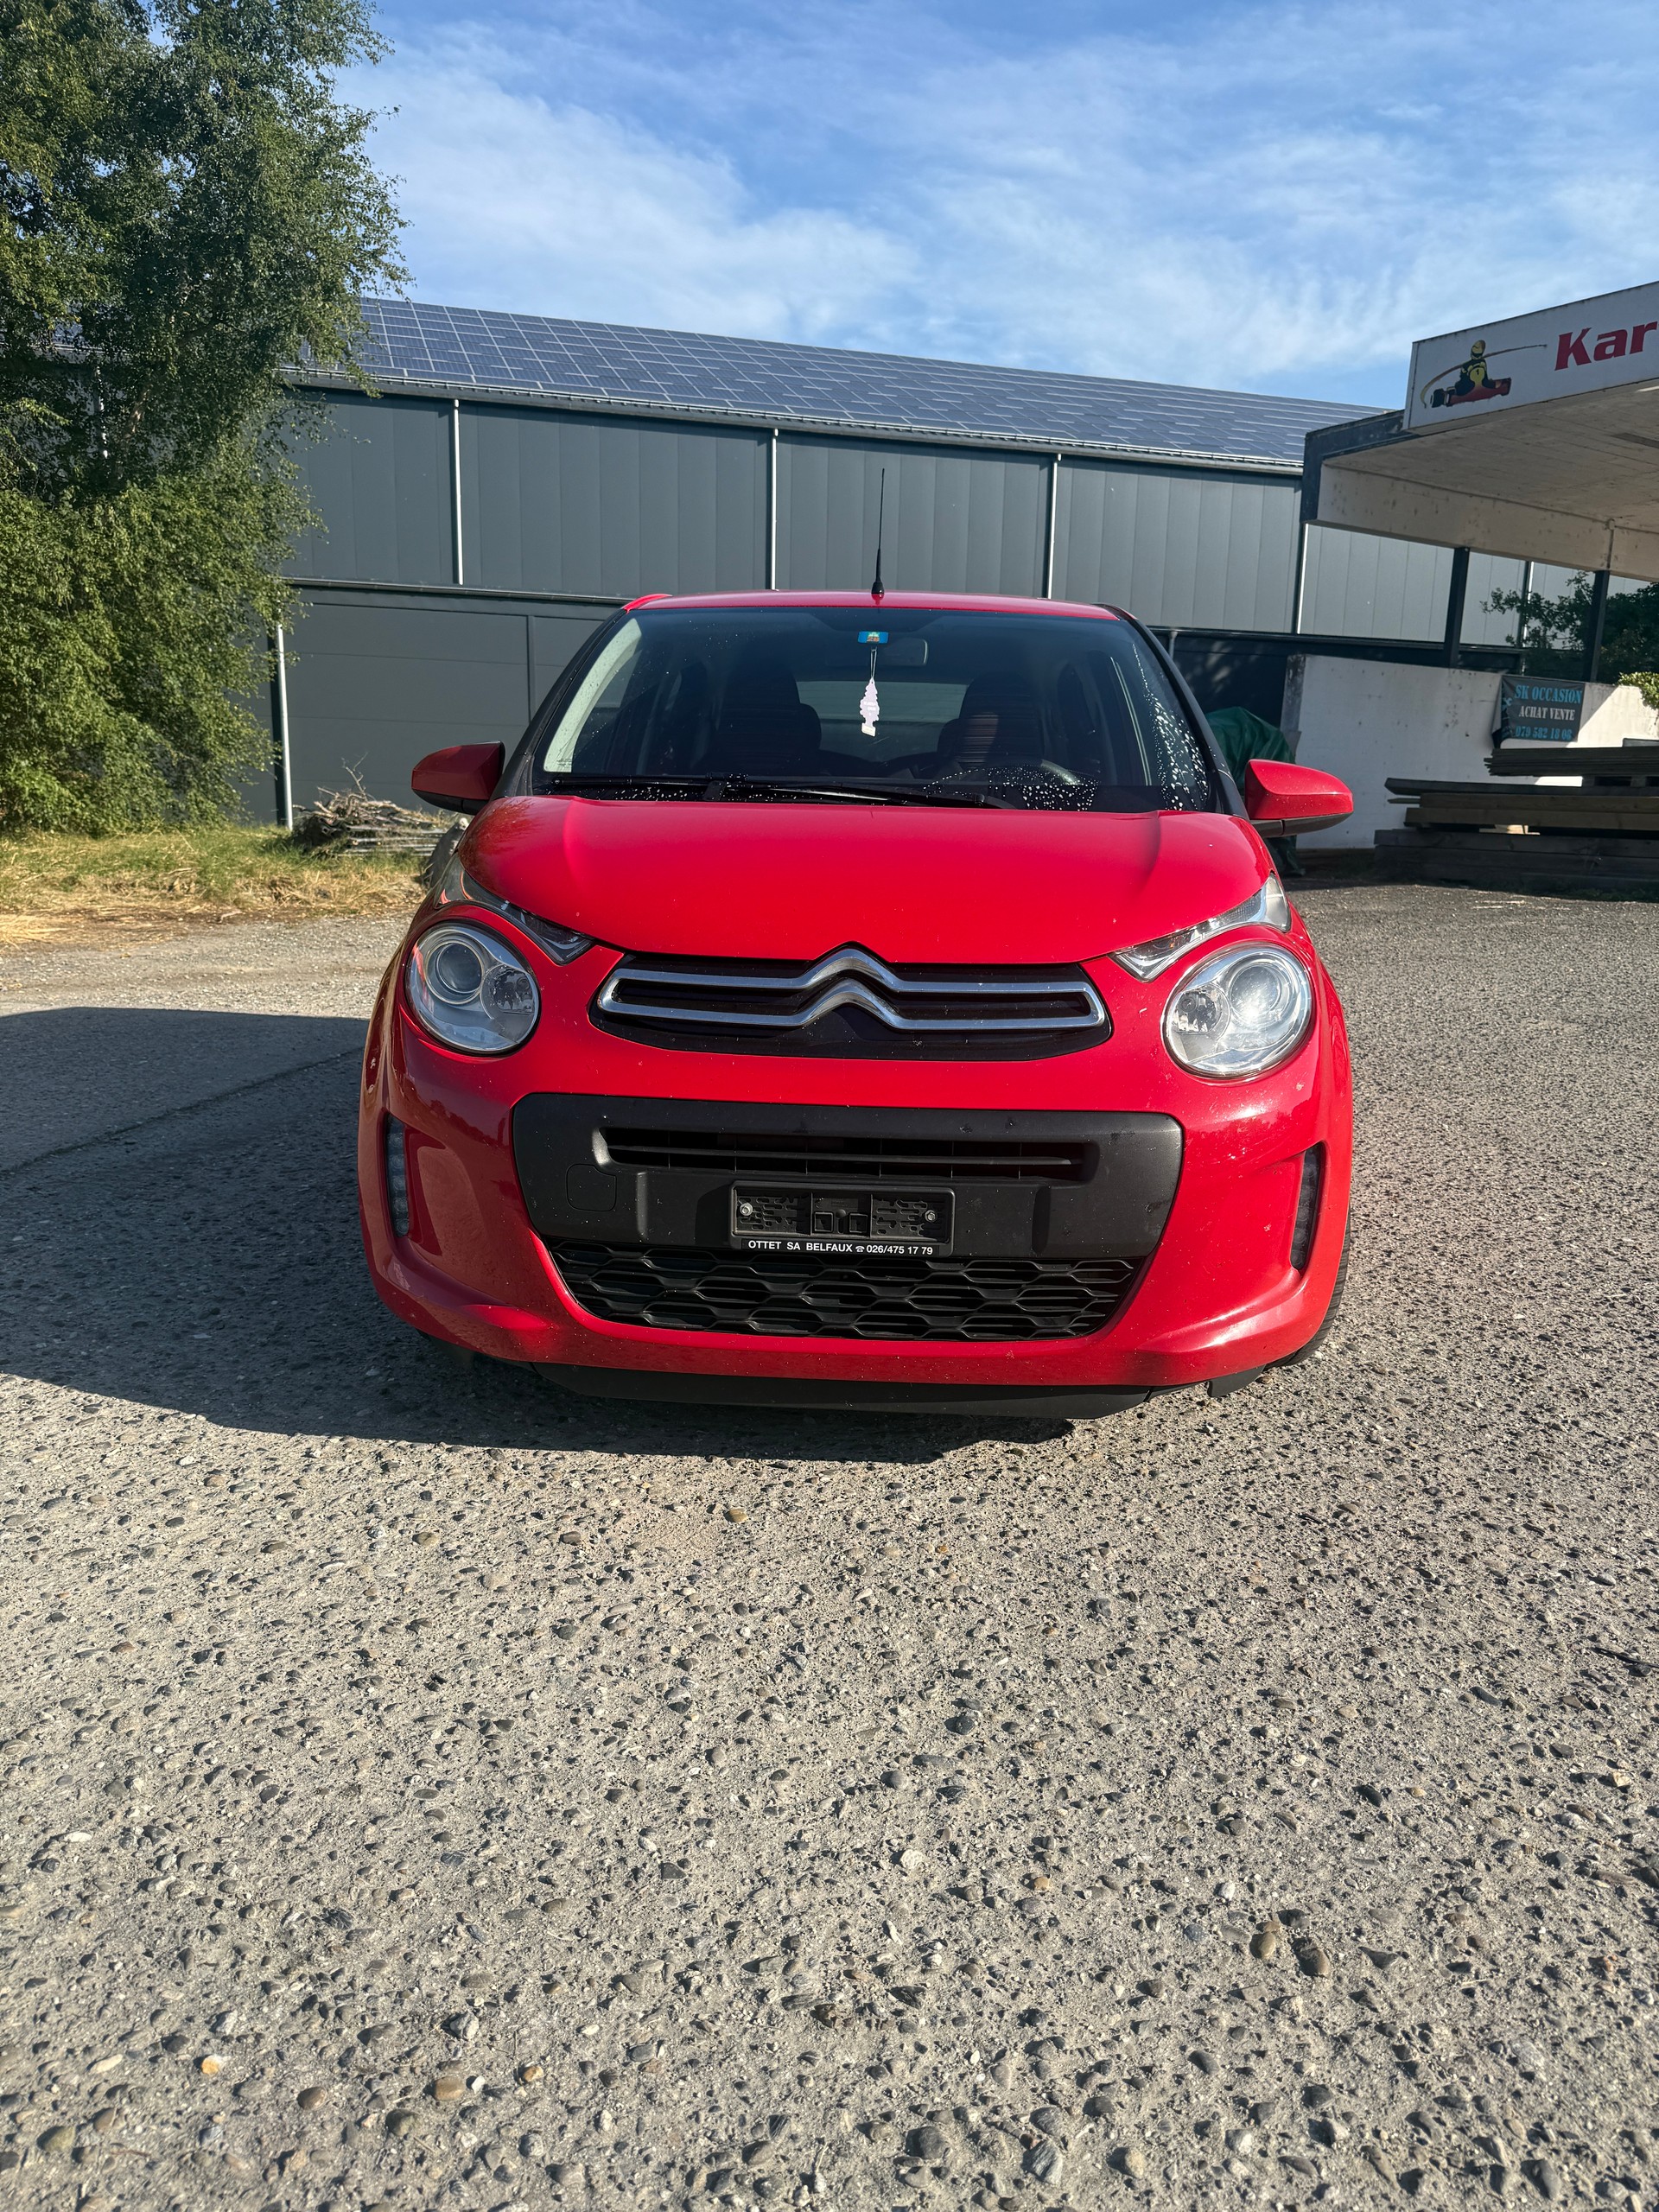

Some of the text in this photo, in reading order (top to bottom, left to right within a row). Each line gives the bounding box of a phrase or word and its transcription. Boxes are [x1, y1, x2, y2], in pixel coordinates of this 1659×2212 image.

[1554, 321, 1659, 371] Kar
[1514, 684, 1582, 704] SK OCCASION
[1518, 705, 1575, 721] ACHAT VENTE
[1515, 725, 1531, 738] 079
[1550, 728, 1560, 740] 18
[748, 1240, 933, 1255] OTTET SA BELFAUX 026/475 17 79
